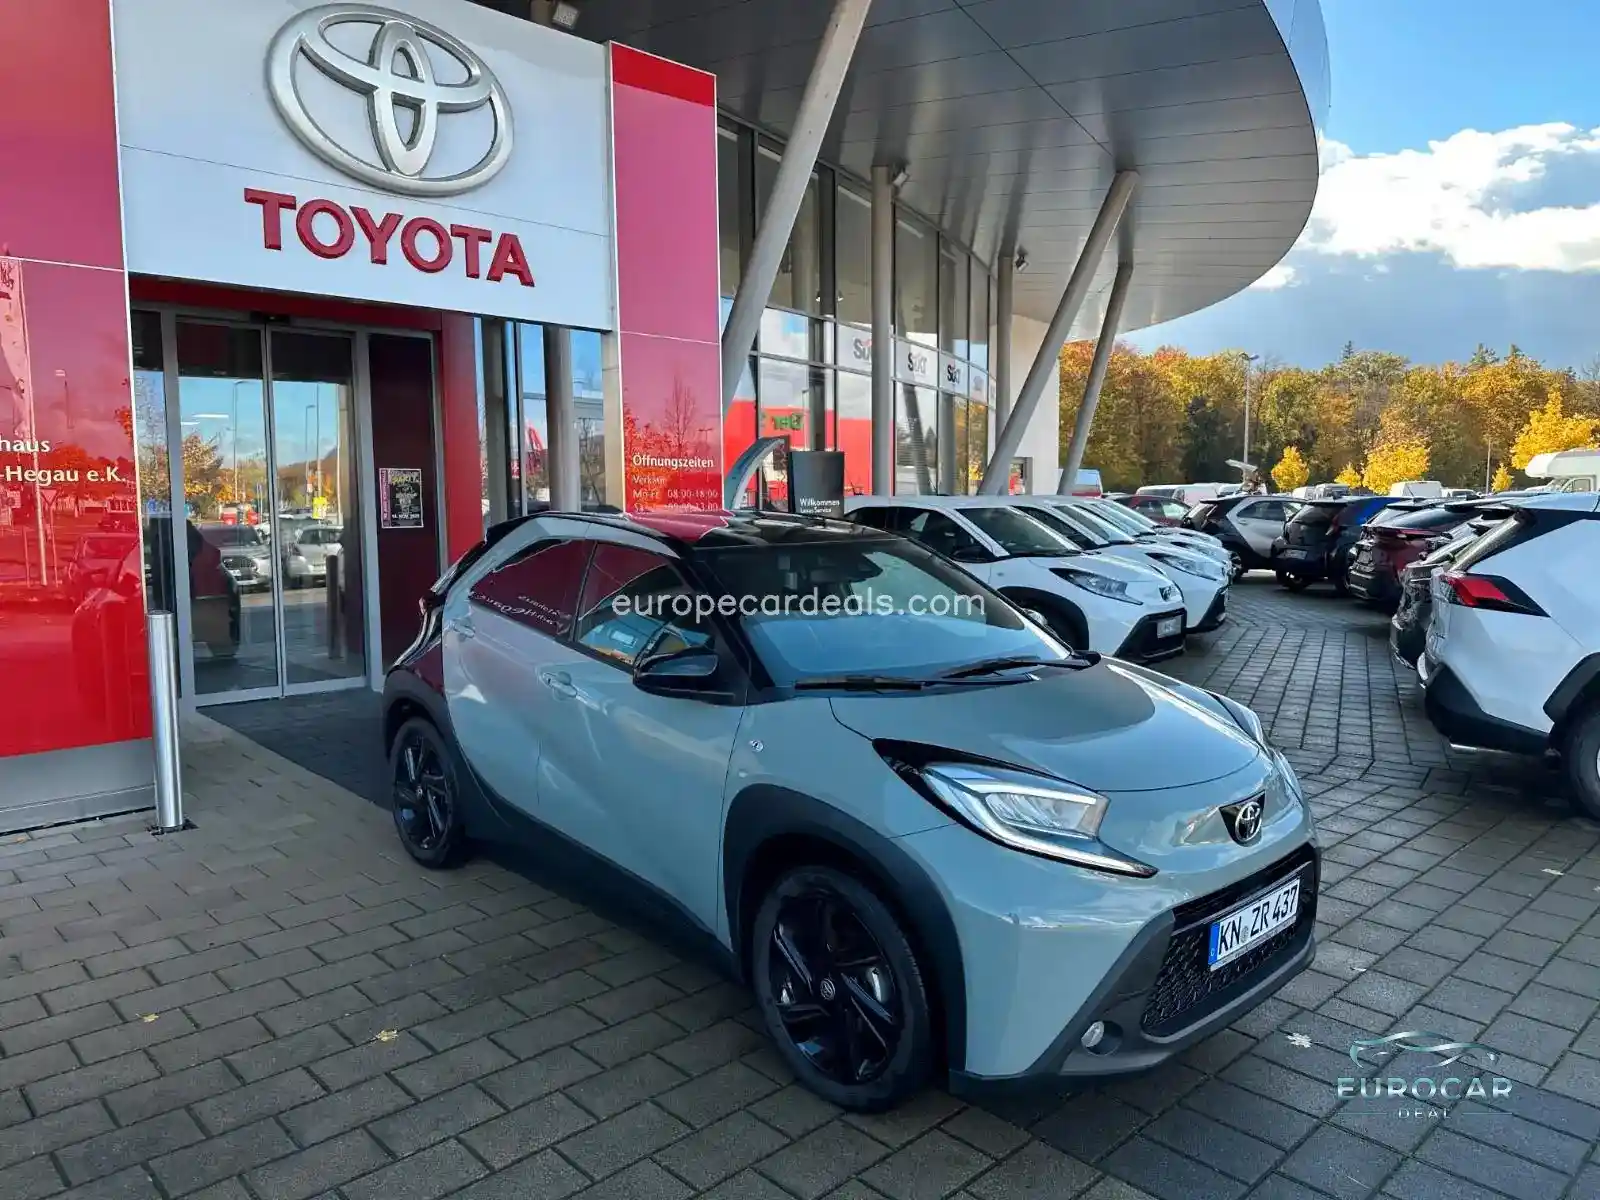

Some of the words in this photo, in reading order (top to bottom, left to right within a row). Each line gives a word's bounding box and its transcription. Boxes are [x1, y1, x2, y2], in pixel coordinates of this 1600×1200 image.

[244, 187, 534, 287] TOYOTA
[633, 453, 714, 470] Öffnungszeiten
[86, 465, 126, 482] e.K.
[800, 498, 840, 506] Willkommen
[1218, 916, 1242, 956] KN
[1250, 901, 1270, 937] ZR
[1272, 885, 1298, 922] 437
